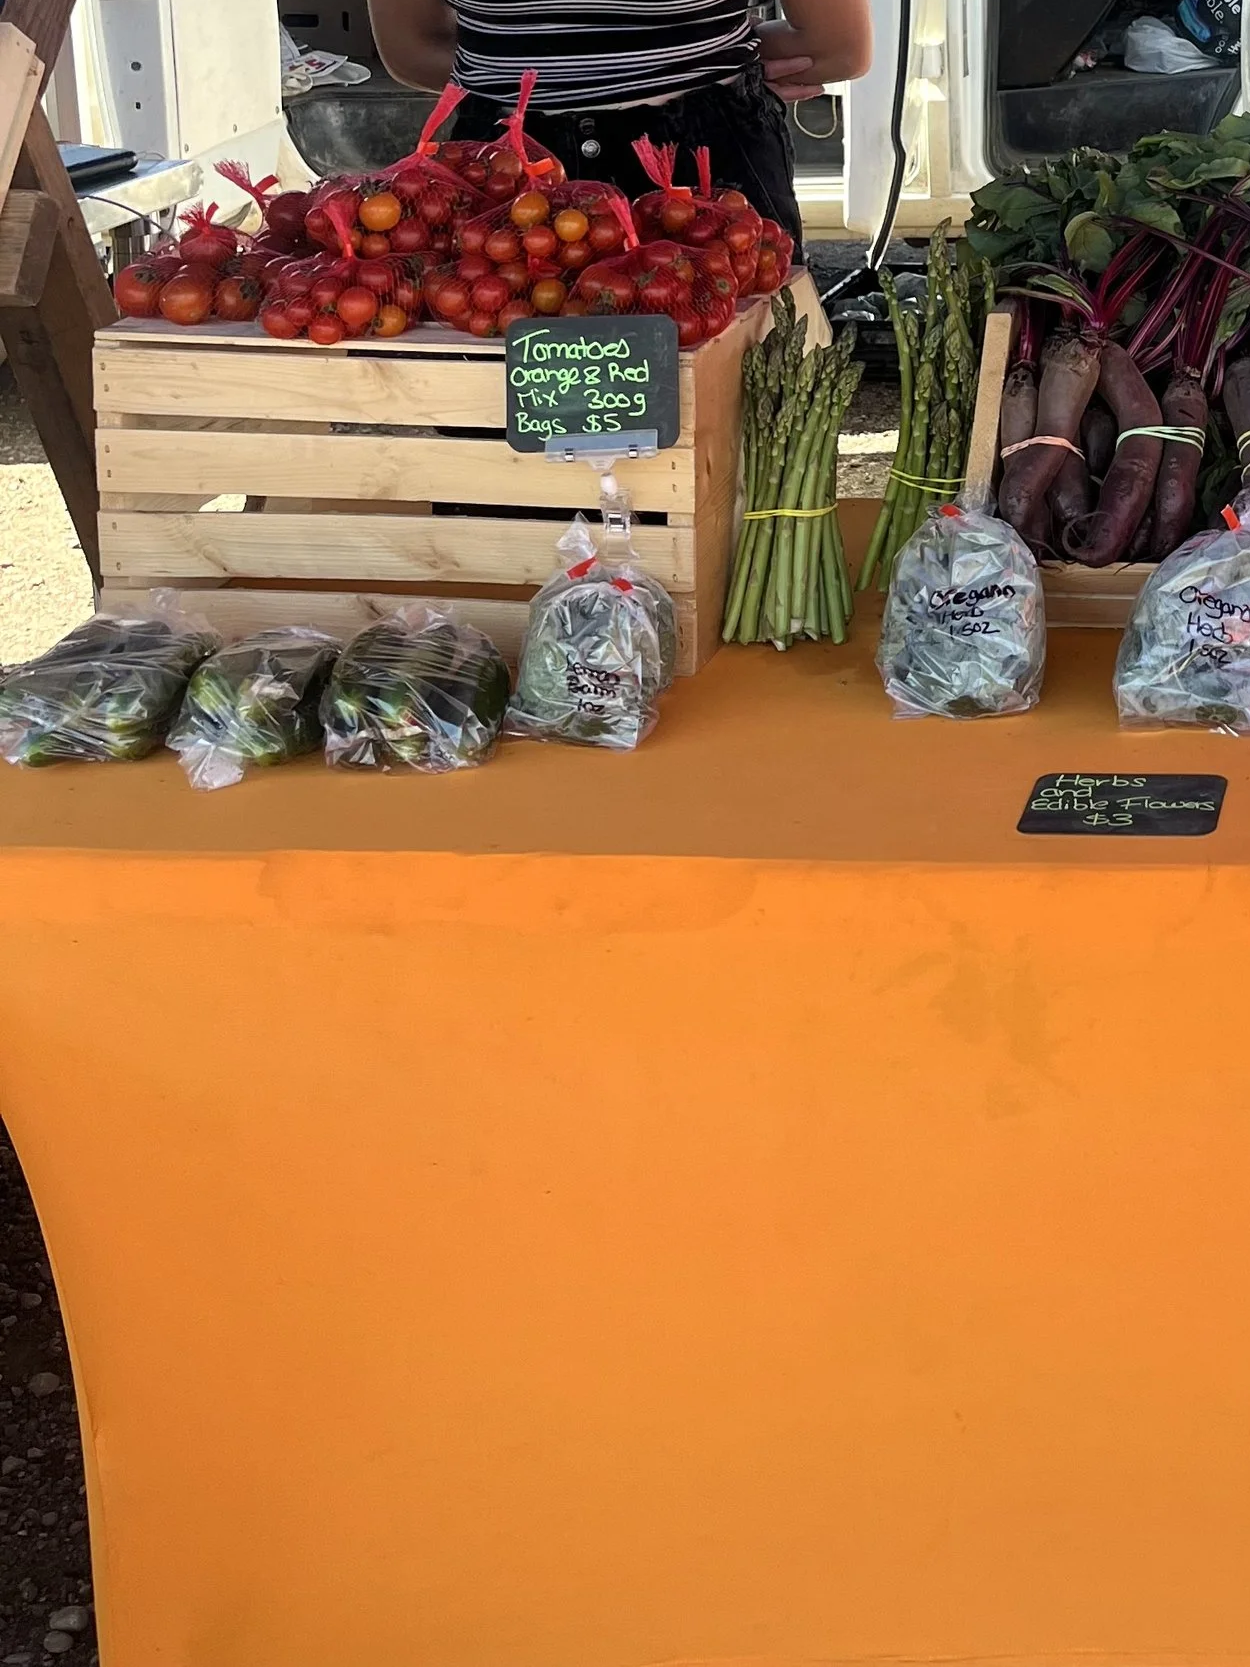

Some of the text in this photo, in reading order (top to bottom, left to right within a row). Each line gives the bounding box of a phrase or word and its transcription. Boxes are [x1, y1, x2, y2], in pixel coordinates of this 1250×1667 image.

[512, 329, 630, 363] Tomatoes
[510, 366, 581, 394] Orange
[608, 359, 649, 382] Red
[517, 388, 558, 408] Mix
[515, 412, 621, 441] Bags $5
[929, 584, 1016, 610] Oregano
[1056, 774, 1147, 787] Herbs
[1040, 786, 1092, 798] and
[1031, 796, 1215, 811] Edible Flowers
[1082, 812, 1133, 827] $3
